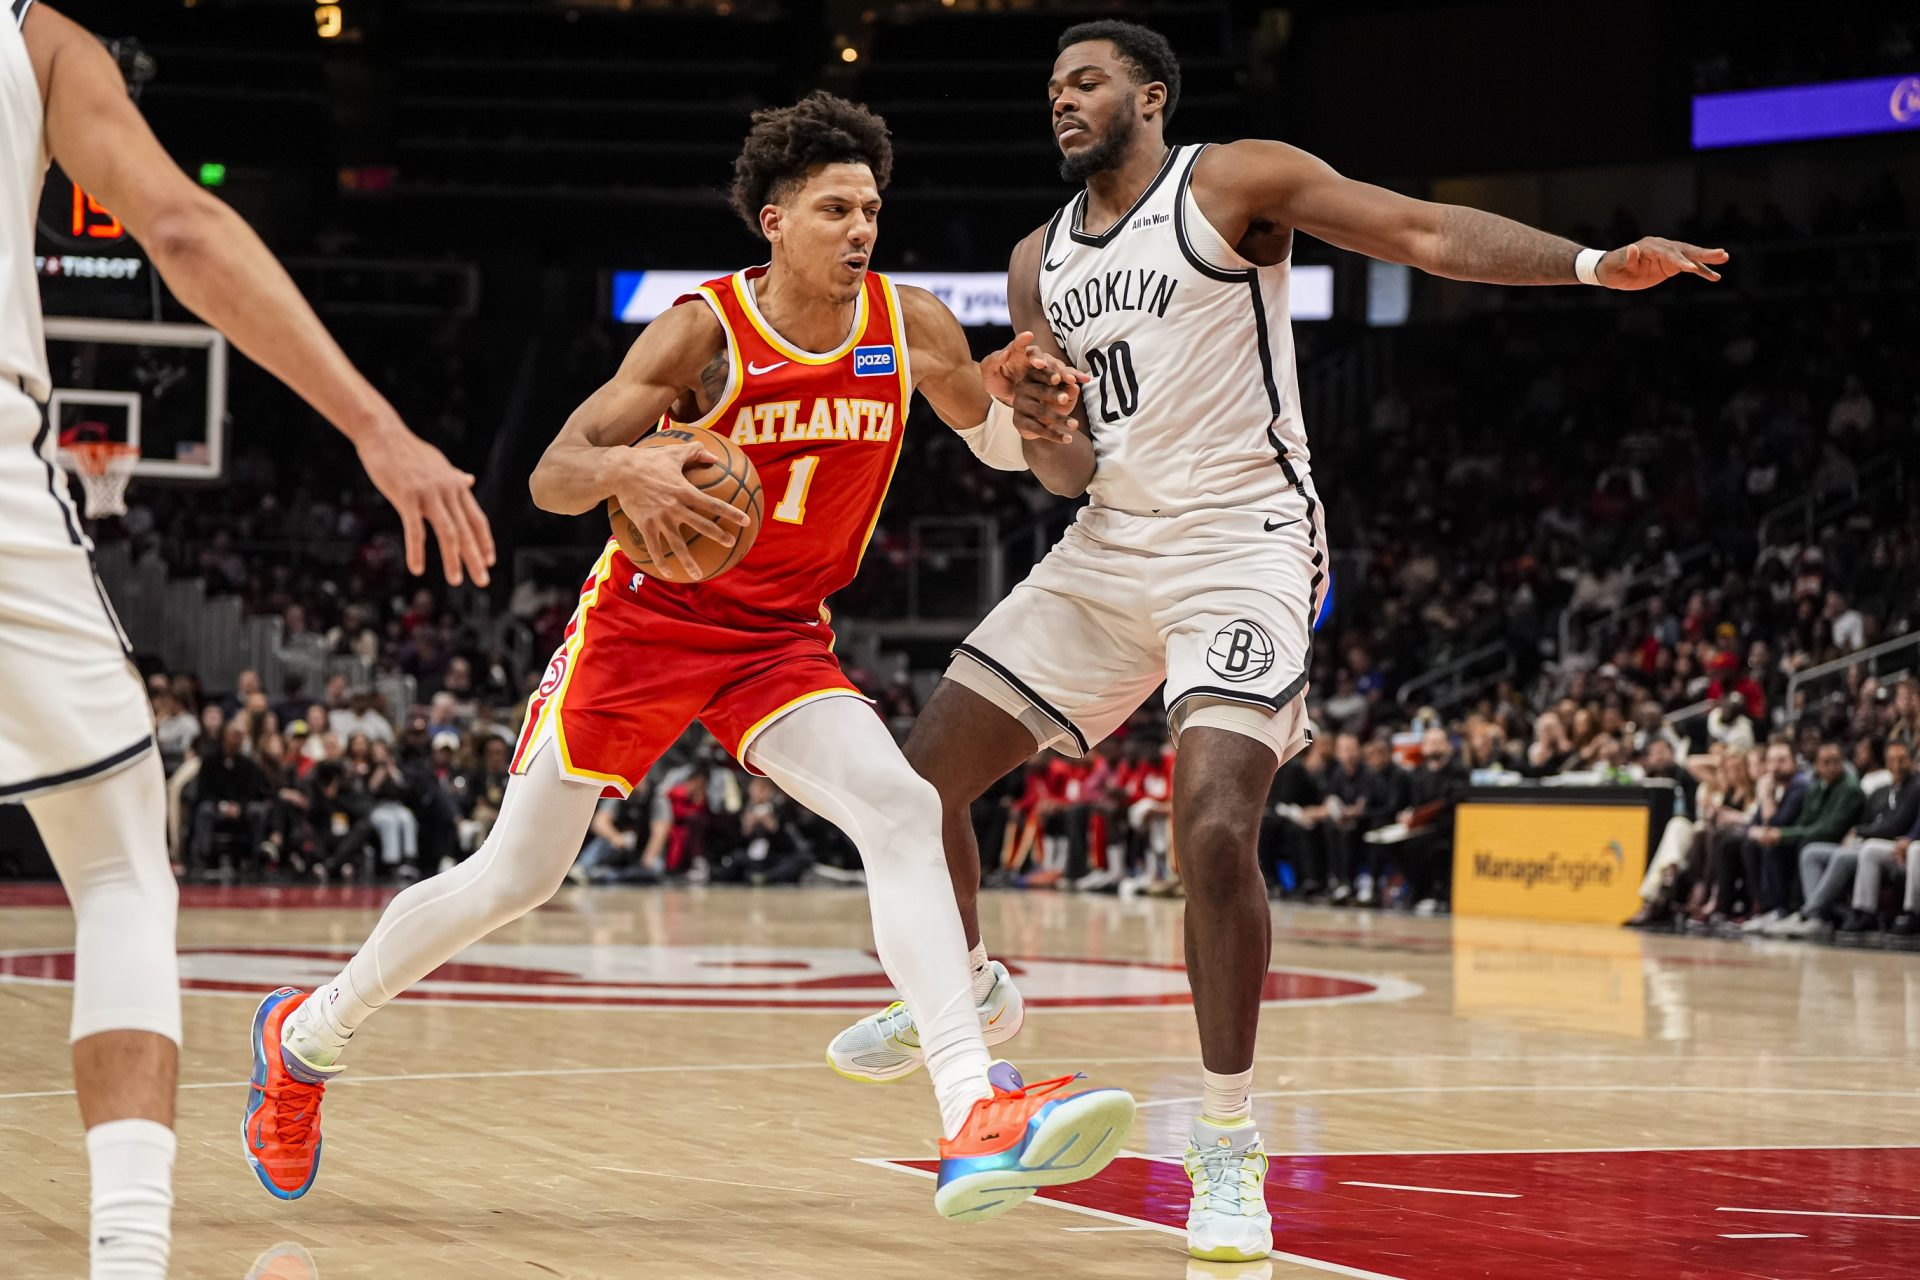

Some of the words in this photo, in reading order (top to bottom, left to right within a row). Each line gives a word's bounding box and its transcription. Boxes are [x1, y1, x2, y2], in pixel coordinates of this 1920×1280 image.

[1132, 218, 1142, 230] All
[1143, 216, 1151, 226] In
[1152, 213, 1169, 224] Won
[61, 256, 141, 279] TISSOT
[857, 353, 891, 369] paze
[1085, 341, 1139, 423] 20
[729, 398, 895, 446] ATLANTA
[772, 455, 820, 525] 1
[1225, 628, 1253, 672] B
[1474, 852, 1612, 891] ManageEngine
